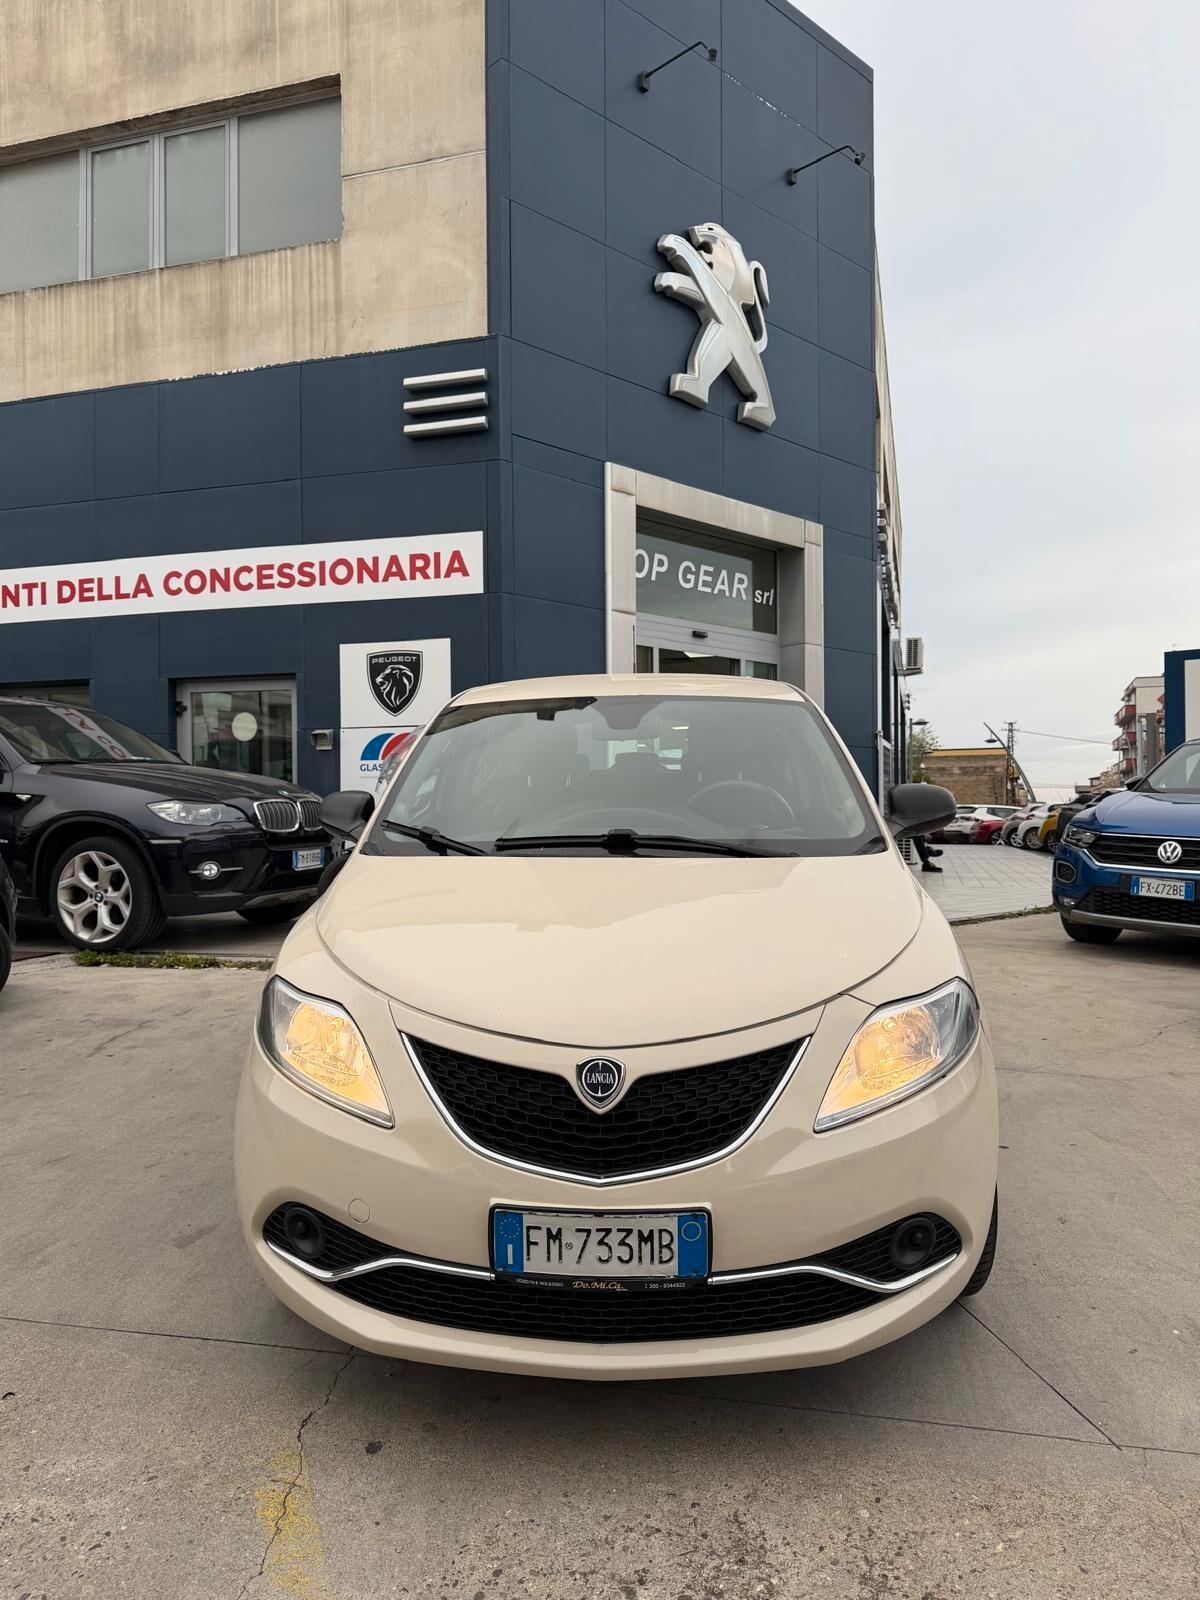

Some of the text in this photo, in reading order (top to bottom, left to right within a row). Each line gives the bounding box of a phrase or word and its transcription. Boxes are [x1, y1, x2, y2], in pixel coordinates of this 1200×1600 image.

[1, 550, 470, 609] NTI DELLA CONCESSIONARIA
[635, 548, 774, 606] OP GEAR srl
[371, 656, 418, 665] PEUGEOT
[586, 1072, 614, 1084] LANCIA
